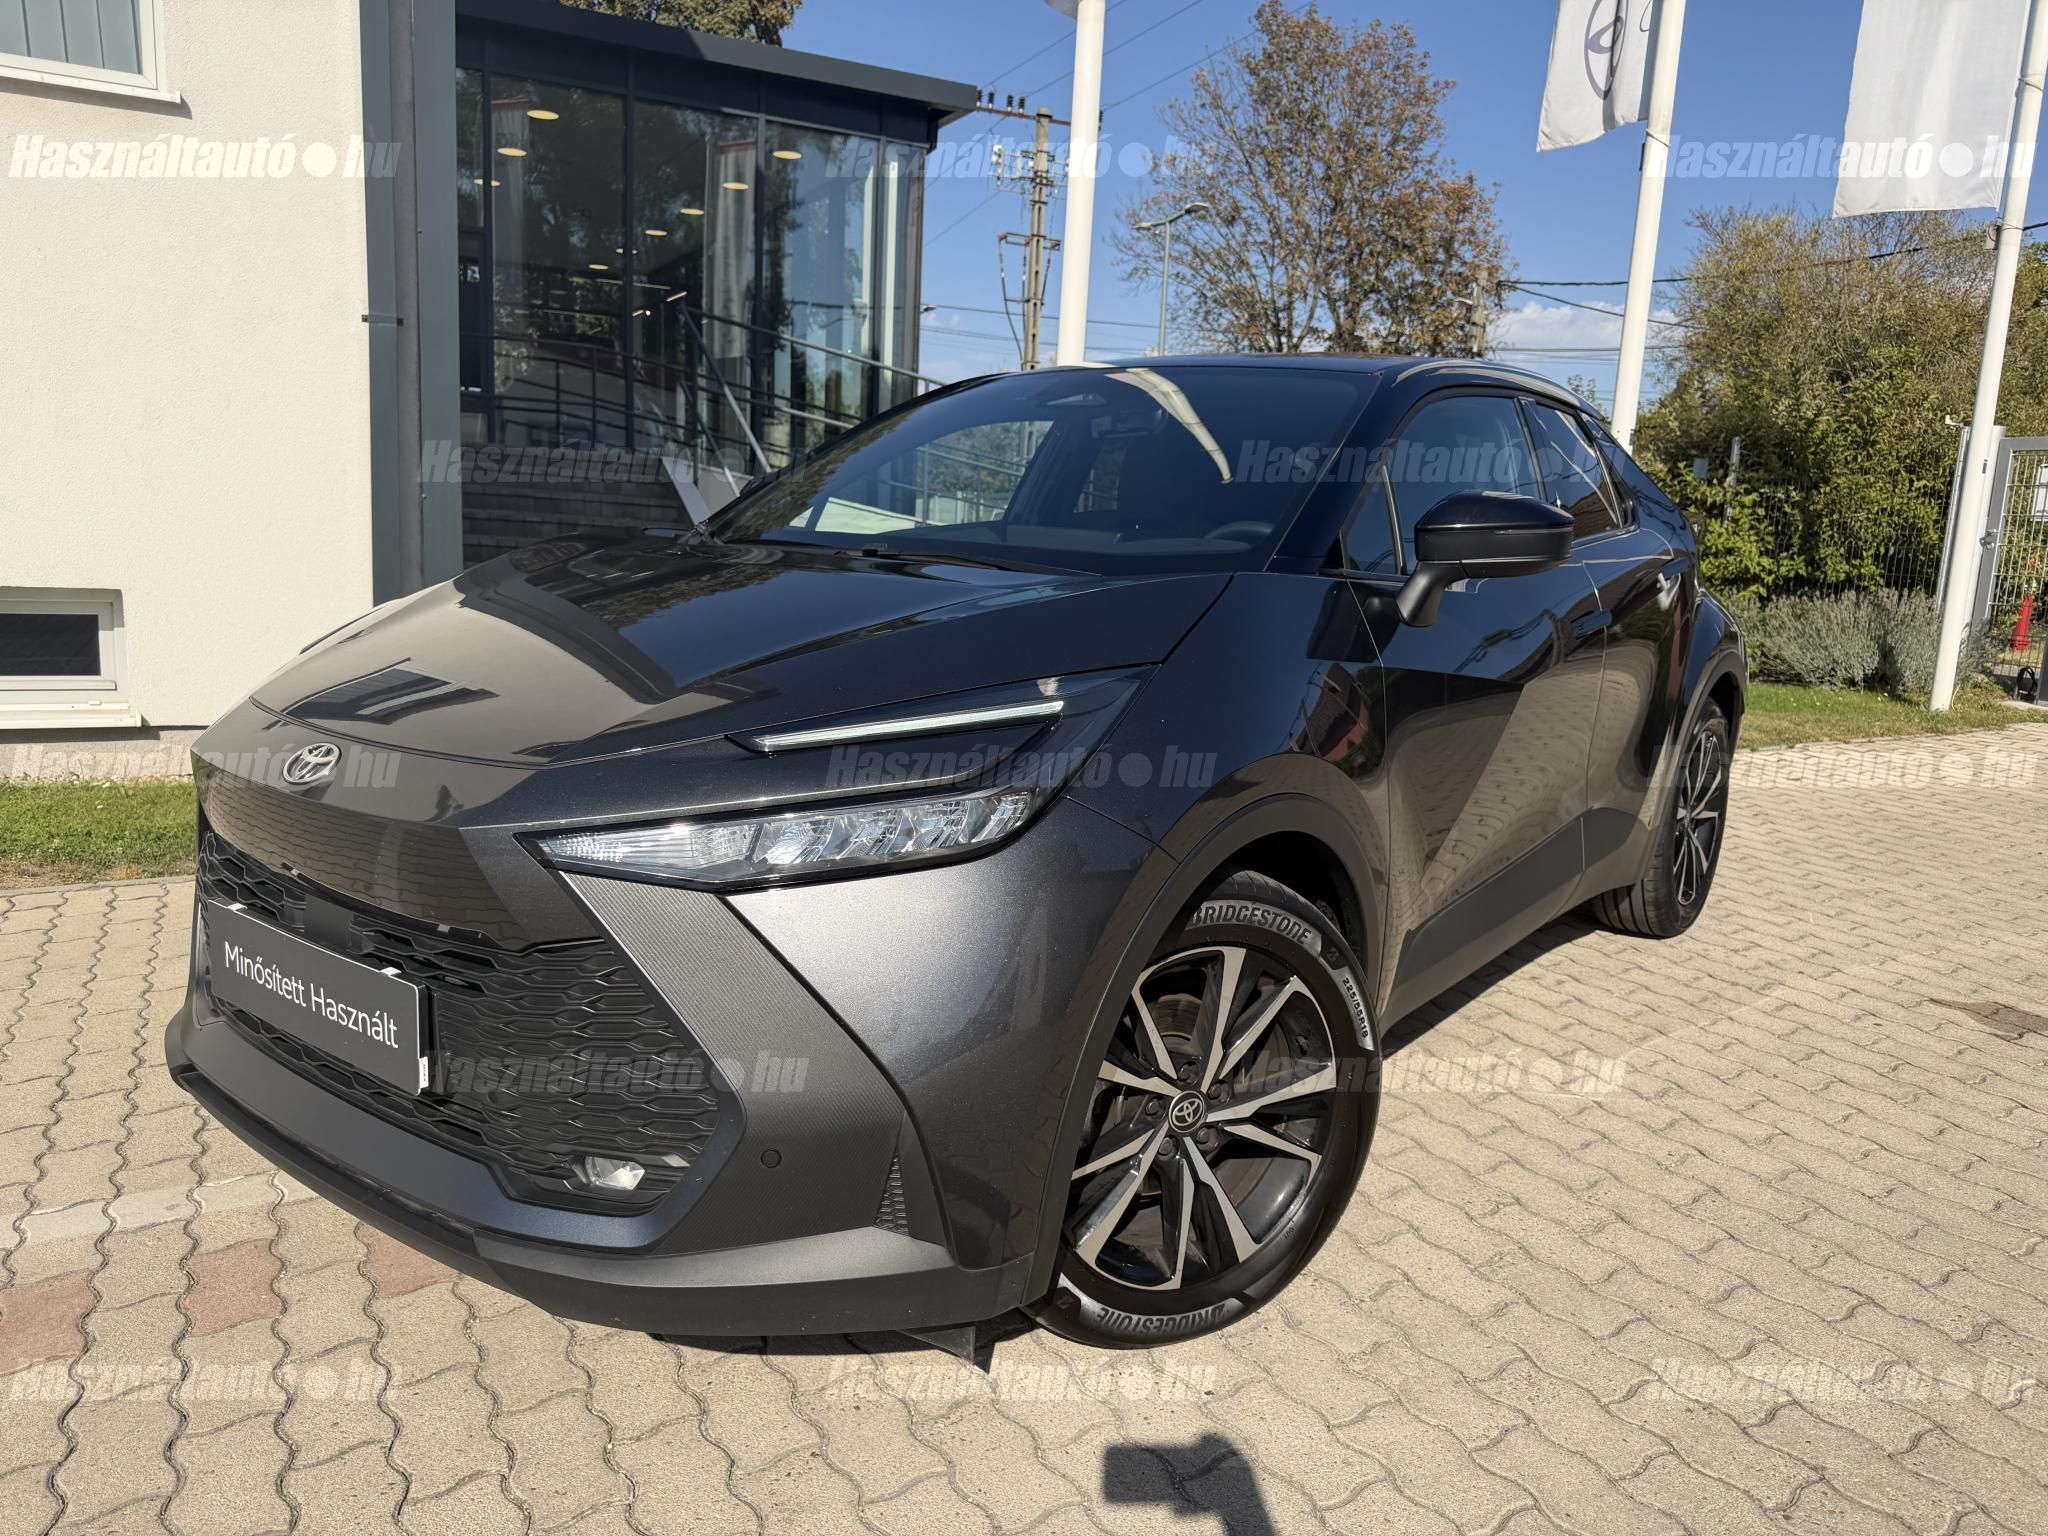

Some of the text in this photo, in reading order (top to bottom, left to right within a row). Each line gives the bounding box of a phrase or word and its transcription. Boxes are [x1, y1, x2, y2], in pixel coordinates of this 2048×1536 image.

[1192, 904, 1312, 945] BRIDGESTONE
[224, 941, 399, 1049] Minősített Használt
[1342, 977, 1369, 1039] 225/55R18
